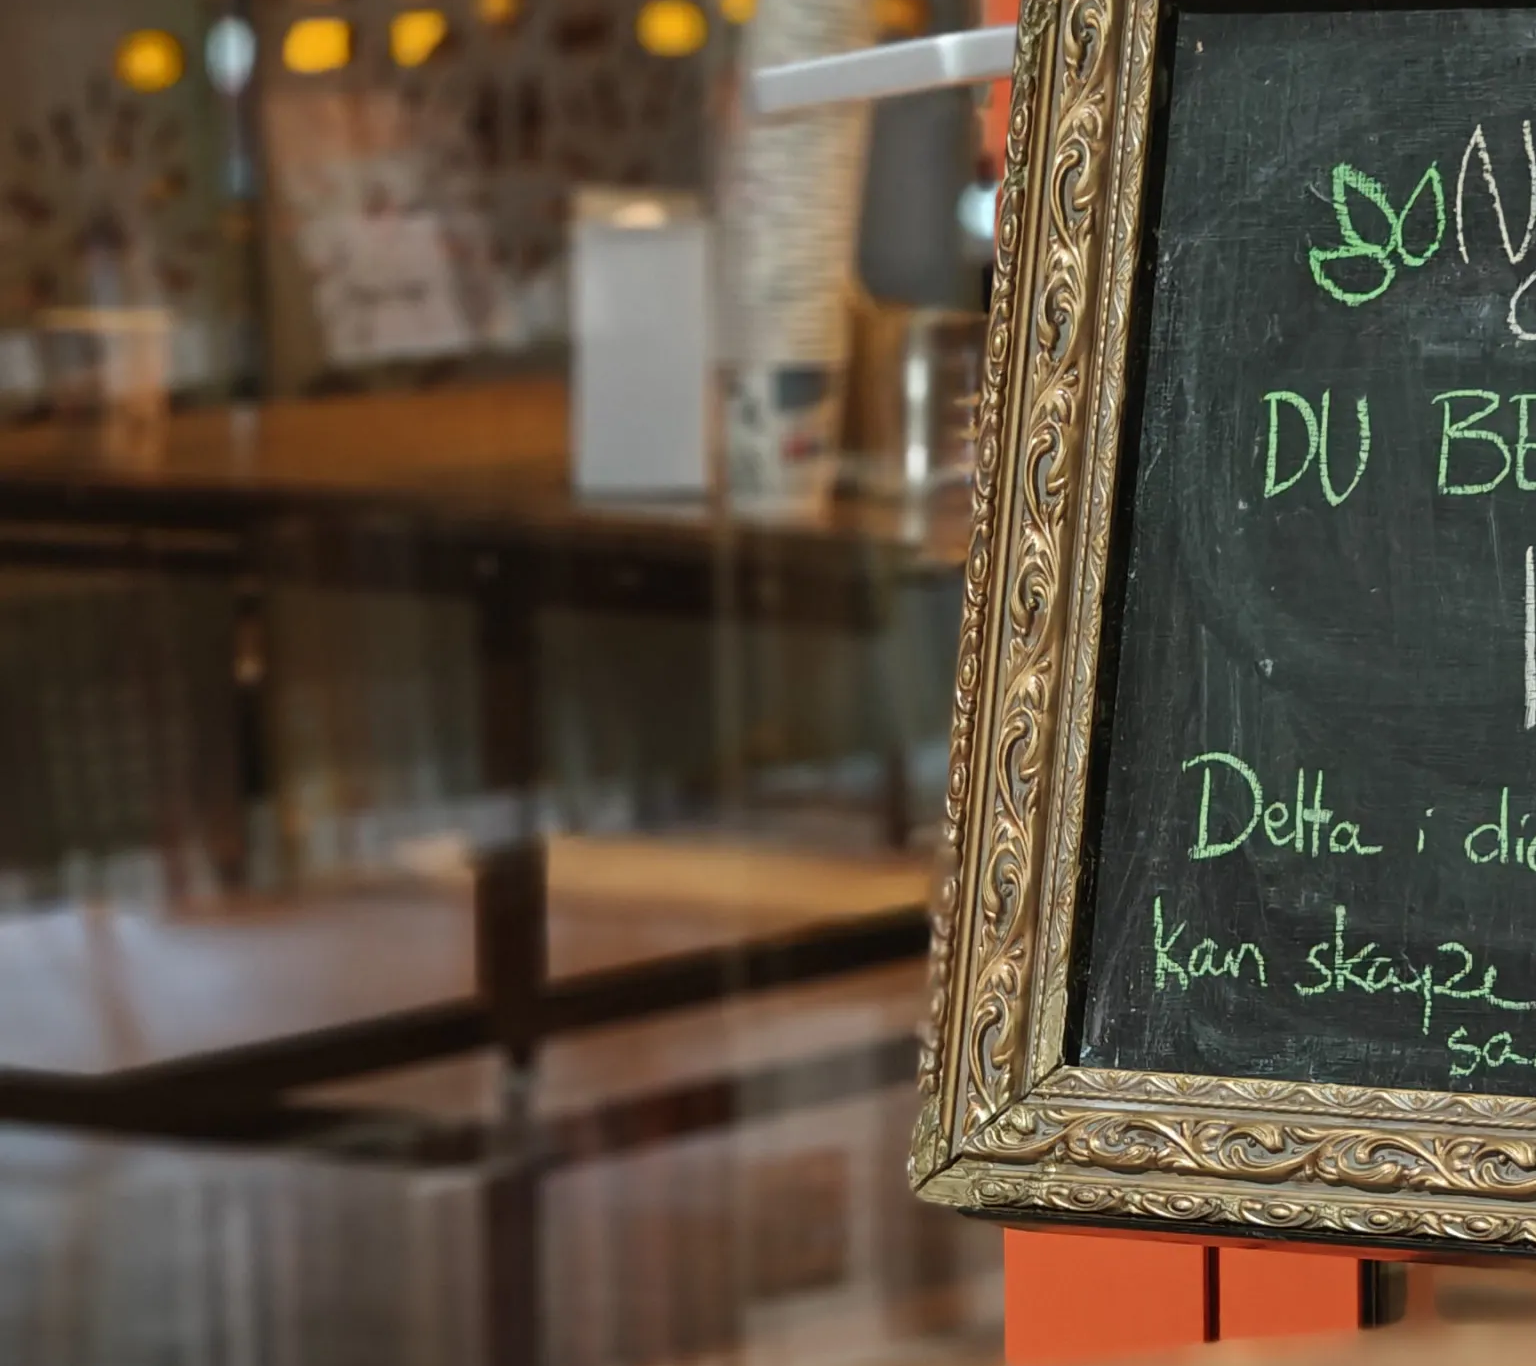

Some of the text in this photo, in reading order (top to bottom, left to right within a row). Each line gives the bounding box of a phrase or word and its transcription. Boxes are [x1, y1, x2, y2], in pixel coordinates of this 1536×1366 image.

[1262, 389, 1371, 507] DU
[1182, 751, 1384, 861] Delta
[1416, 807, 1436, 854] i
